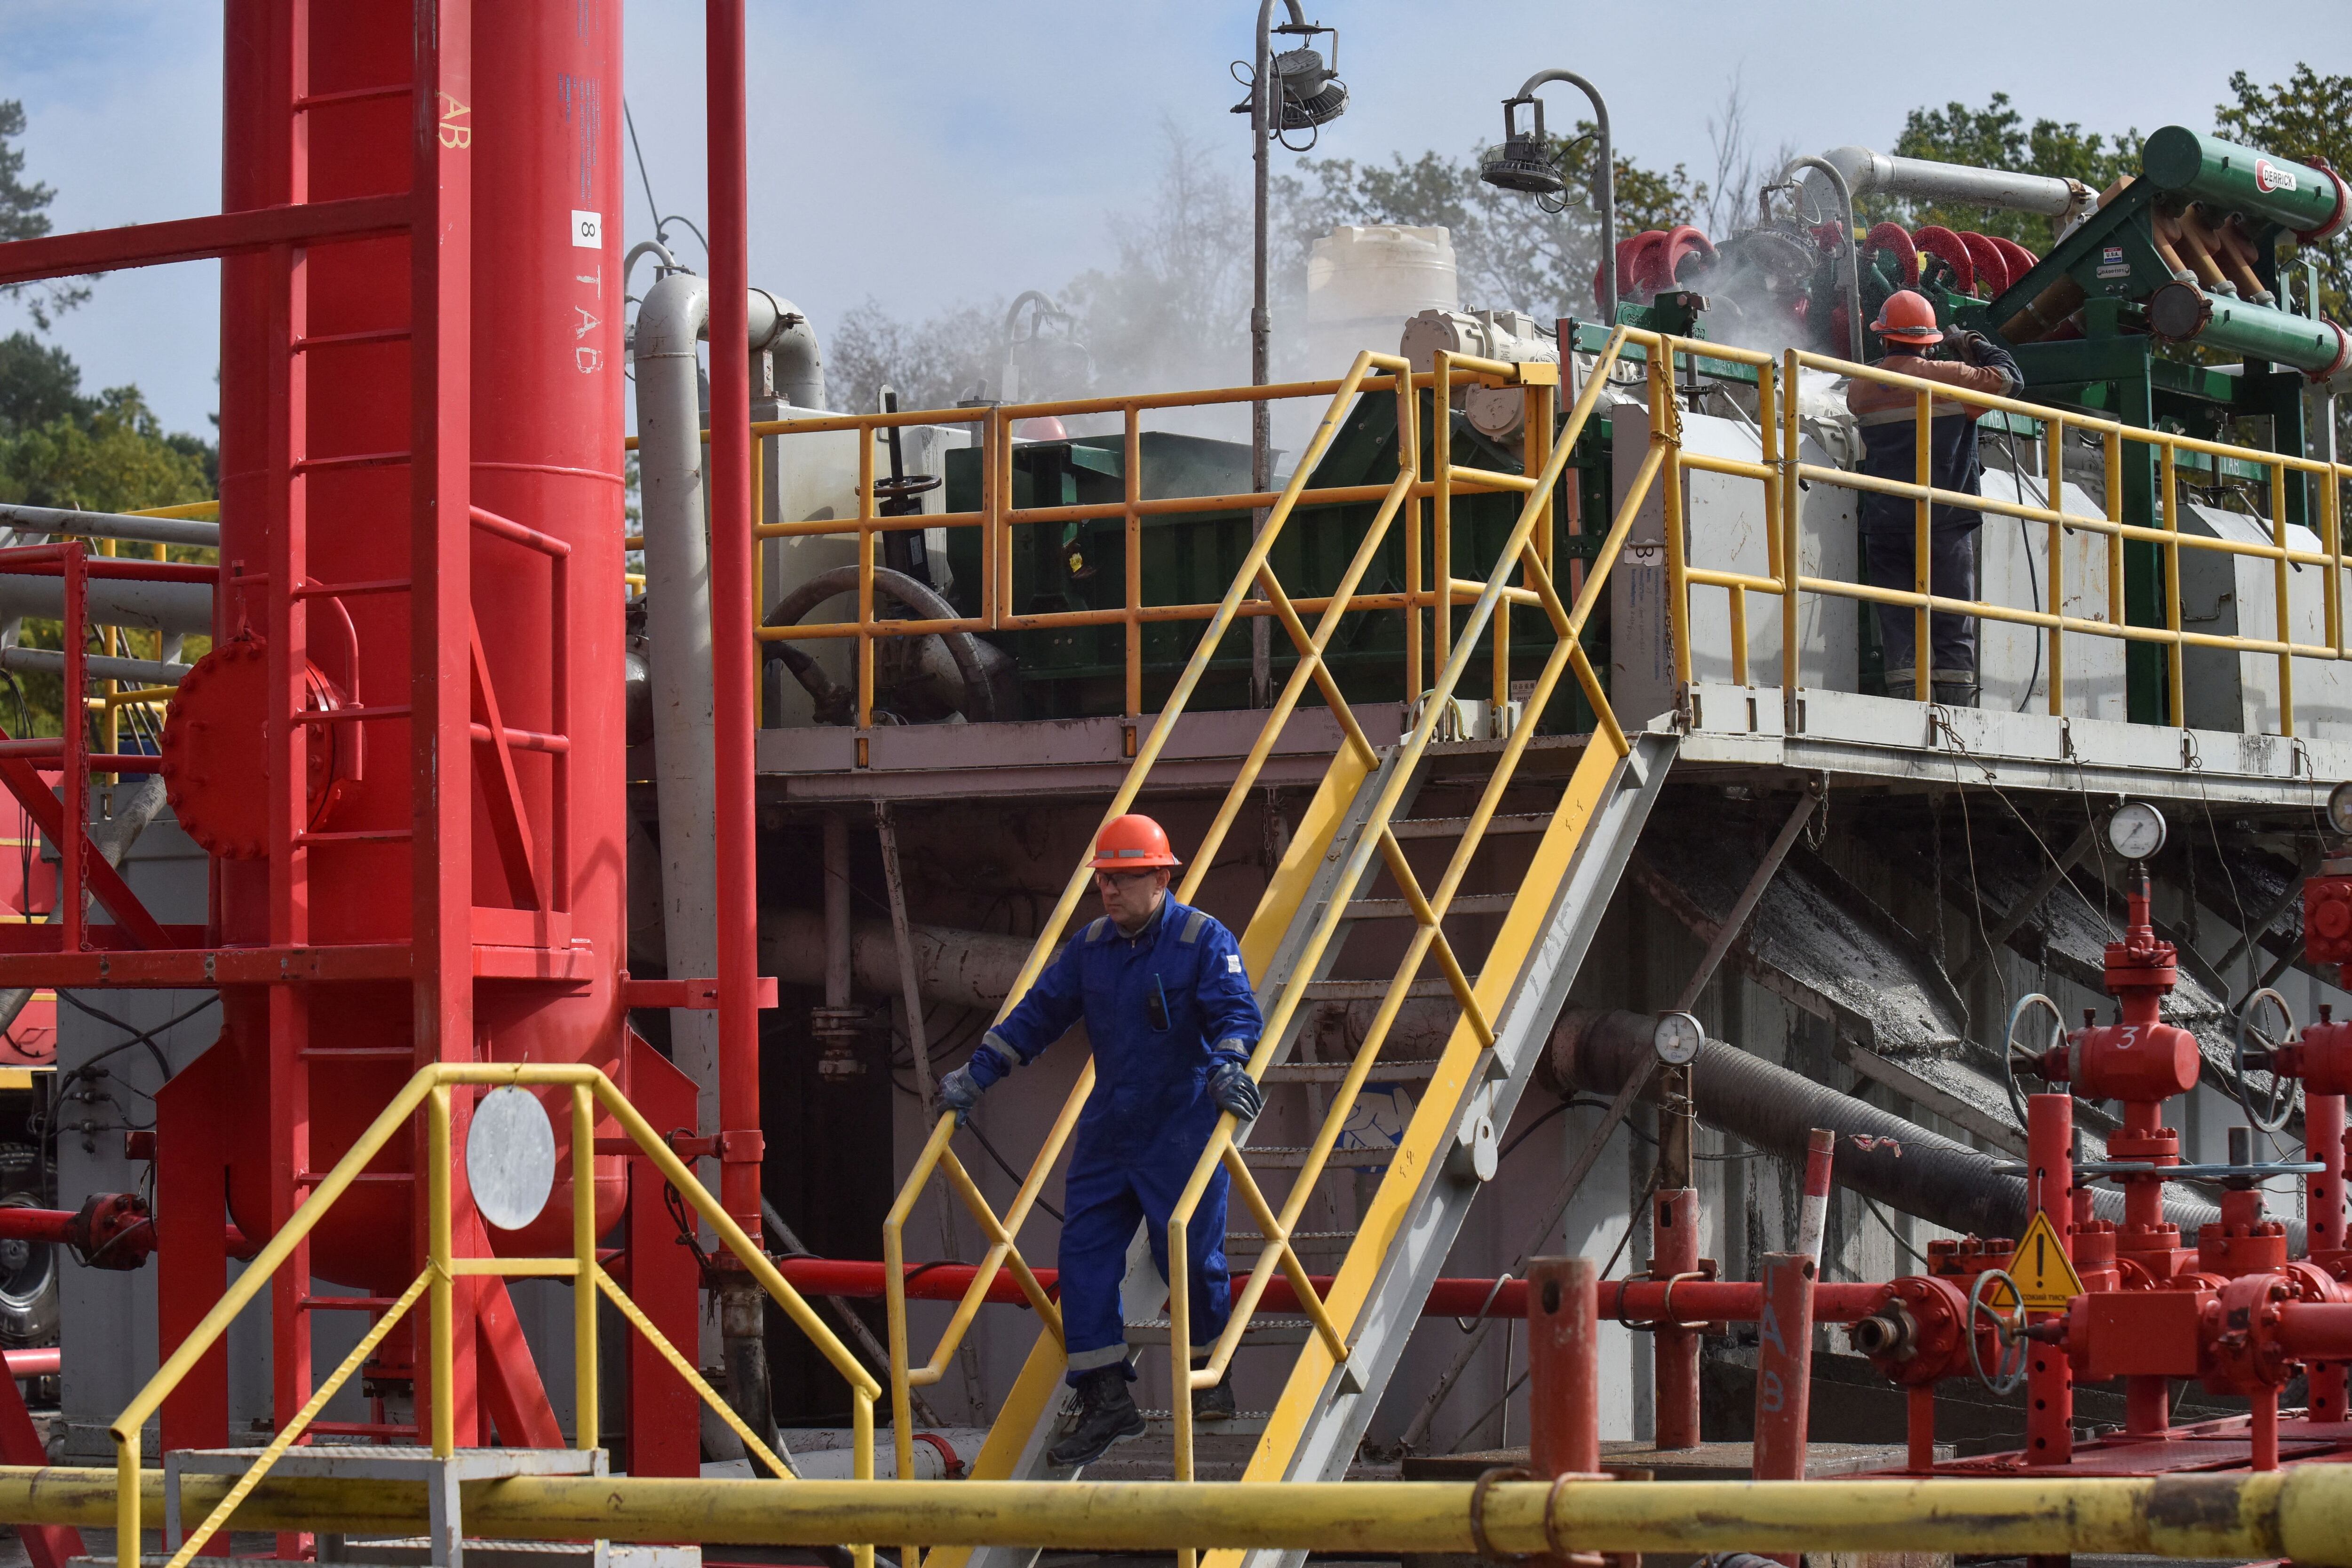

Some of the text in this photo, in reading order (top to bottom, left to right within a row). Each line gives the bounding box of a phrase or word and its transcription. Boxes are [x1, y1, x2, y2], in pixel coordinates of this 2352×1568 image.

[435, 89, 471, 149] AB
[2265, 170, 2293, 187] DERRICK
[581, 222, 595, 237] 8
[2116, 1026, 2140, 1049] 3
